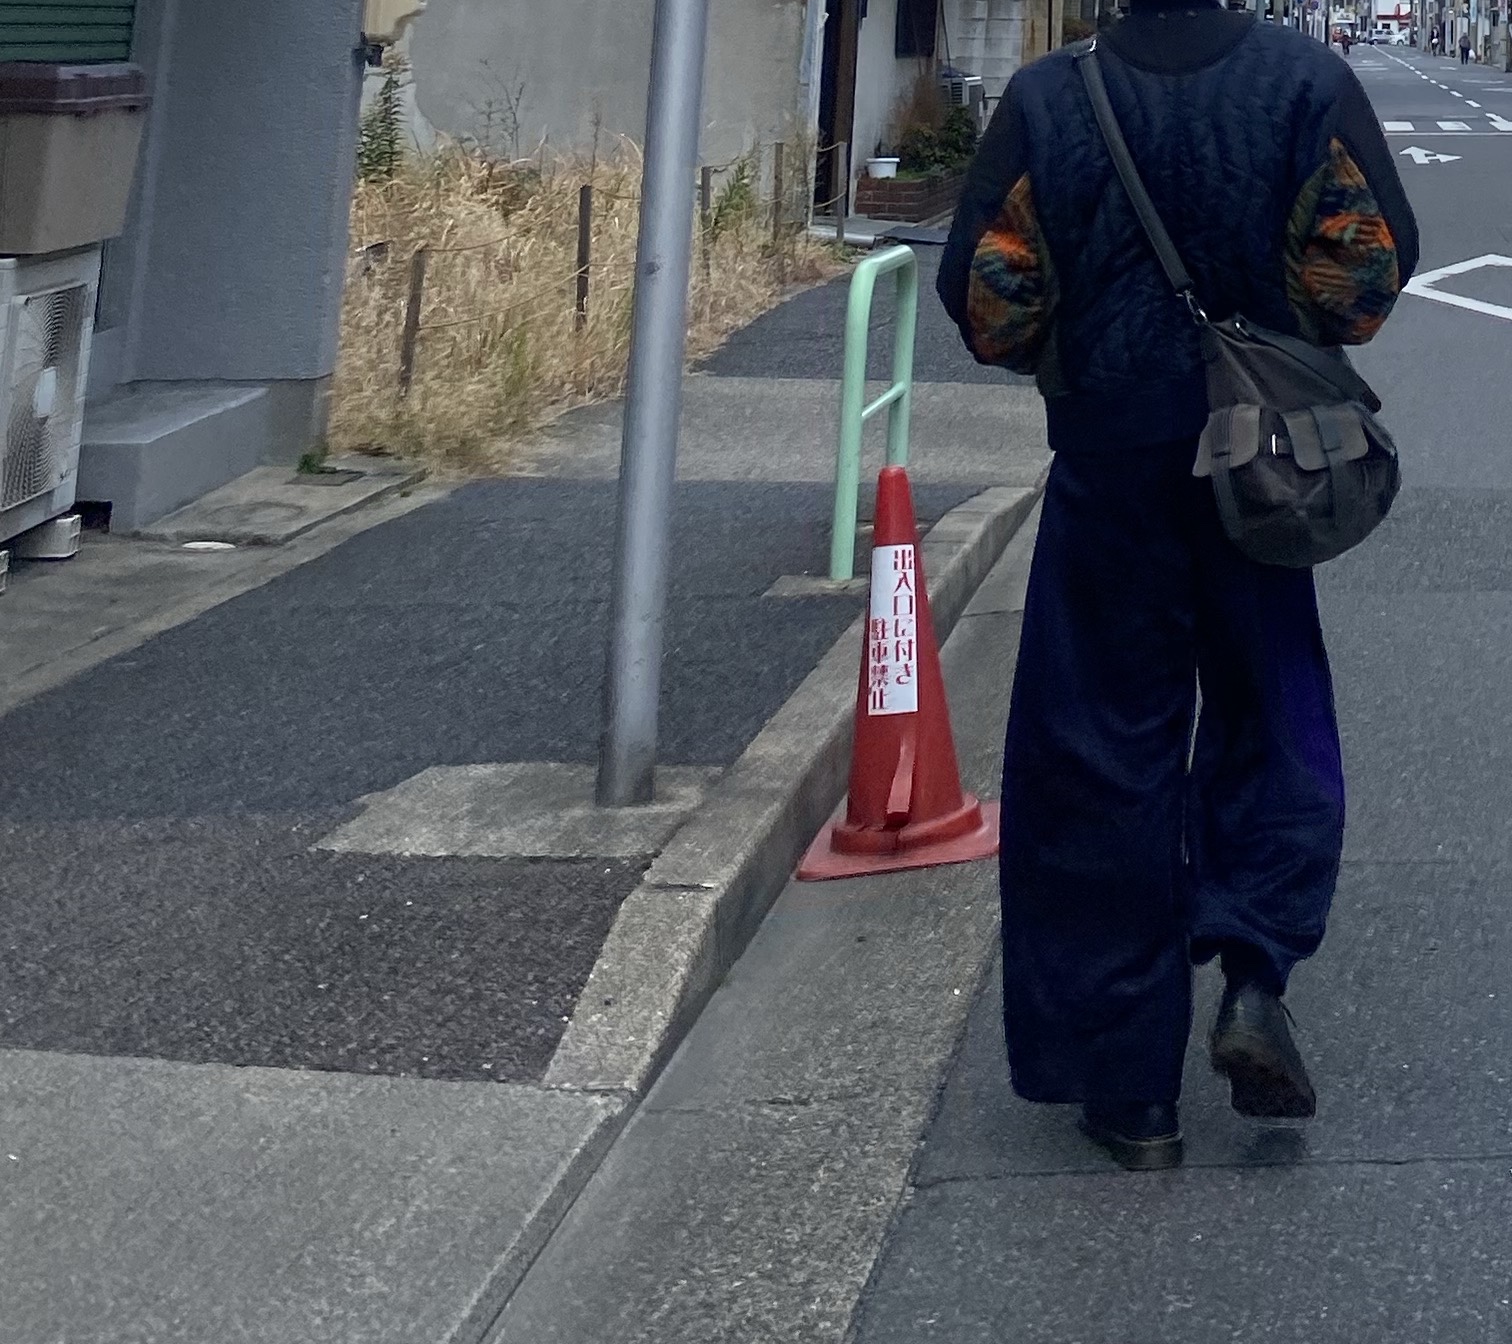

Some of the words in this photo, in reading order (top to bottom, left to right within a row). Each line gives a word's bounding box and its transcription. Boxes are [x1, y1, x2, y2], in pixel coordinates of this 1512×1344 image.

[870, 617, 890, 710] 駐車禁止
[893, 549, 915, 685] 出入口に付き
